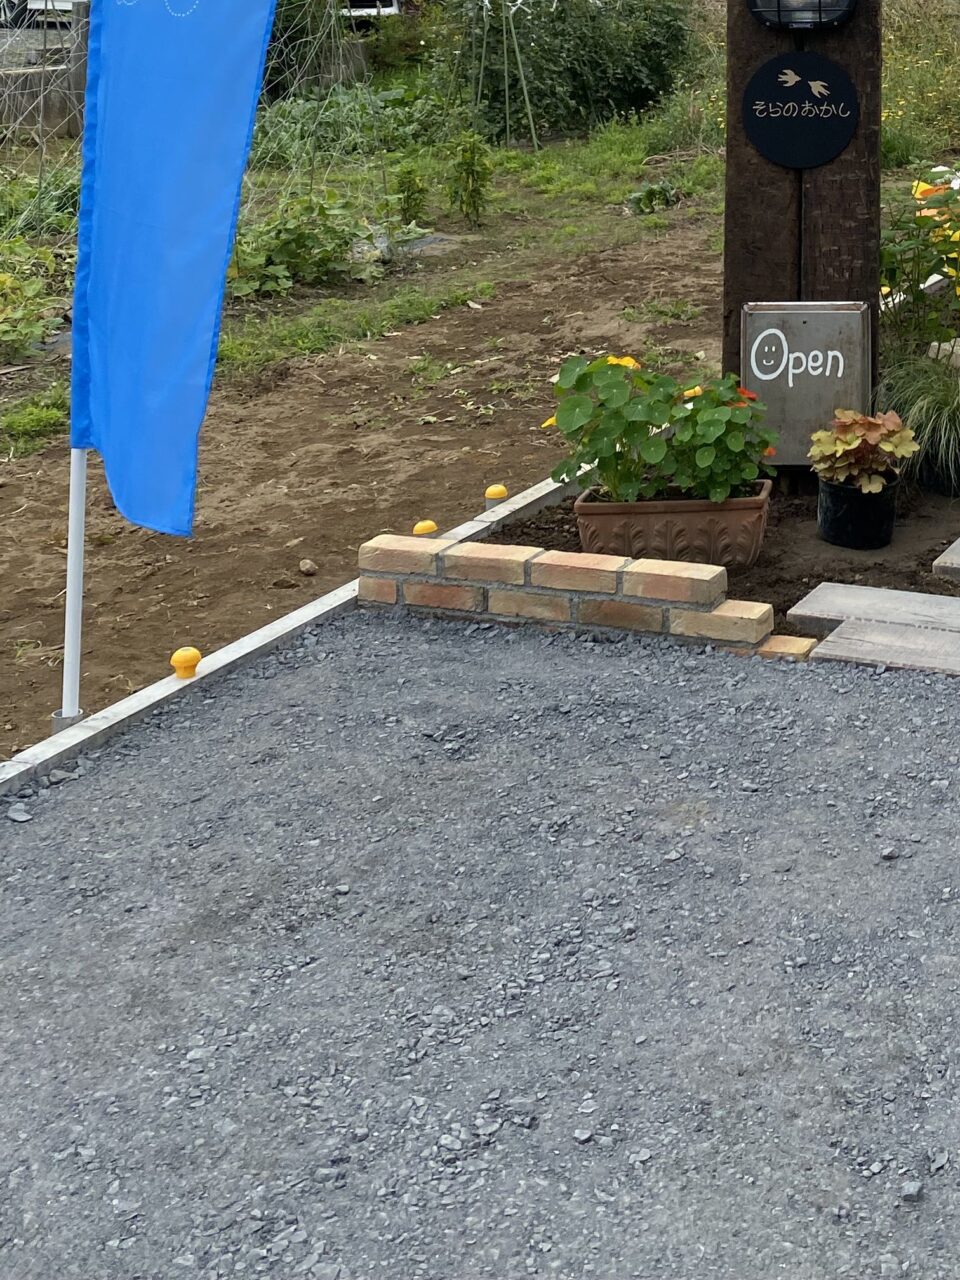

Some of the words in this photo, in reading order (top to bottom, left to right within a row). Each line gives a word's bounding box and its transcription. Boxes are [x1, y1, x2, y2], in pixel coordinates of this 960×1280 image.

[752, 100, 851, 118] そらのおかし
[750, 328, 845, 388] Open
